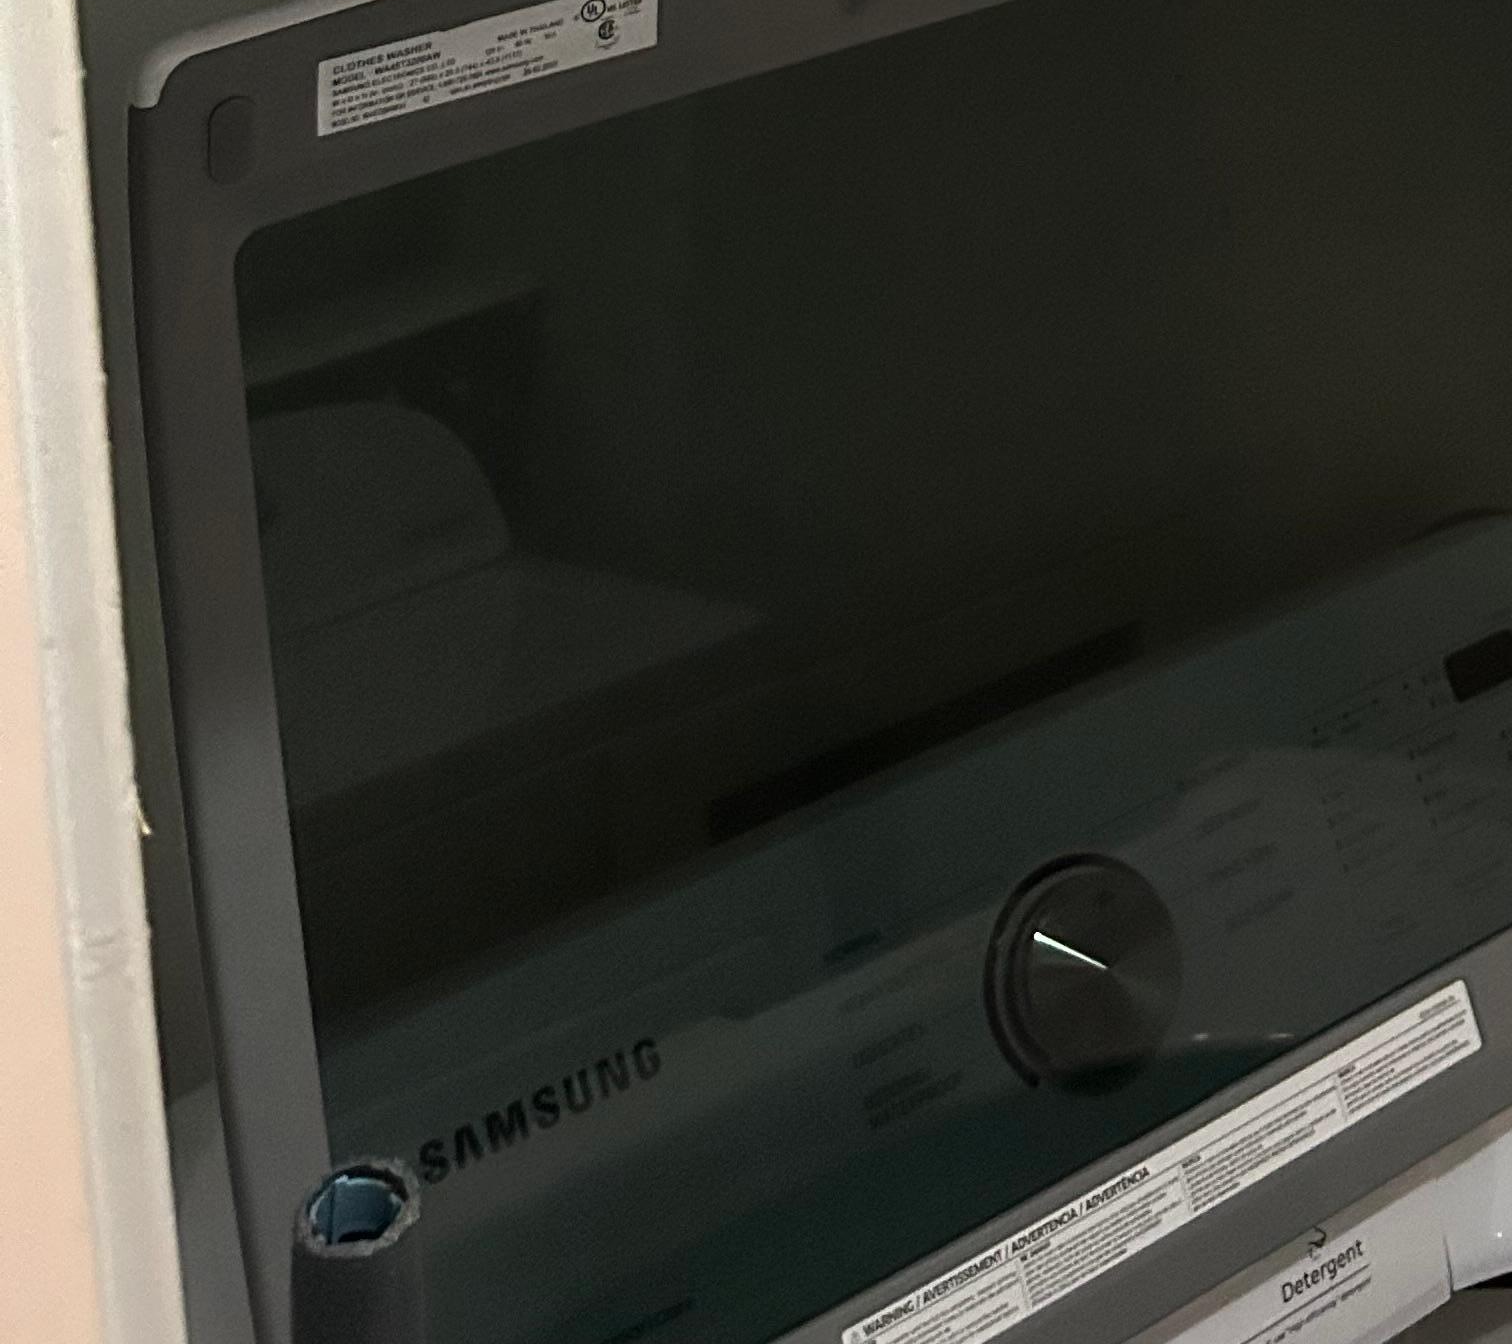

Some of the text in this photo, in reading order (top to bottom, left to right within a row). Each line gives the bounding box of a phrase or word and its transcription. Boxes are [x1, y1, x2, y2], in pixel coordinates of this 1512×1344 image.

[386, 41, 433, 61] WASHER
[418, 1037, 661, 1184] SAMSUNG
[862, 1299, 915, 1336] WARNING
[922, 1250, 1003, 1305] AVERTISSEMENT
[1010, 1207, 1078, 1253] ADVERTENCIA
[1281, 1239, 1364, 1303] Detergent
